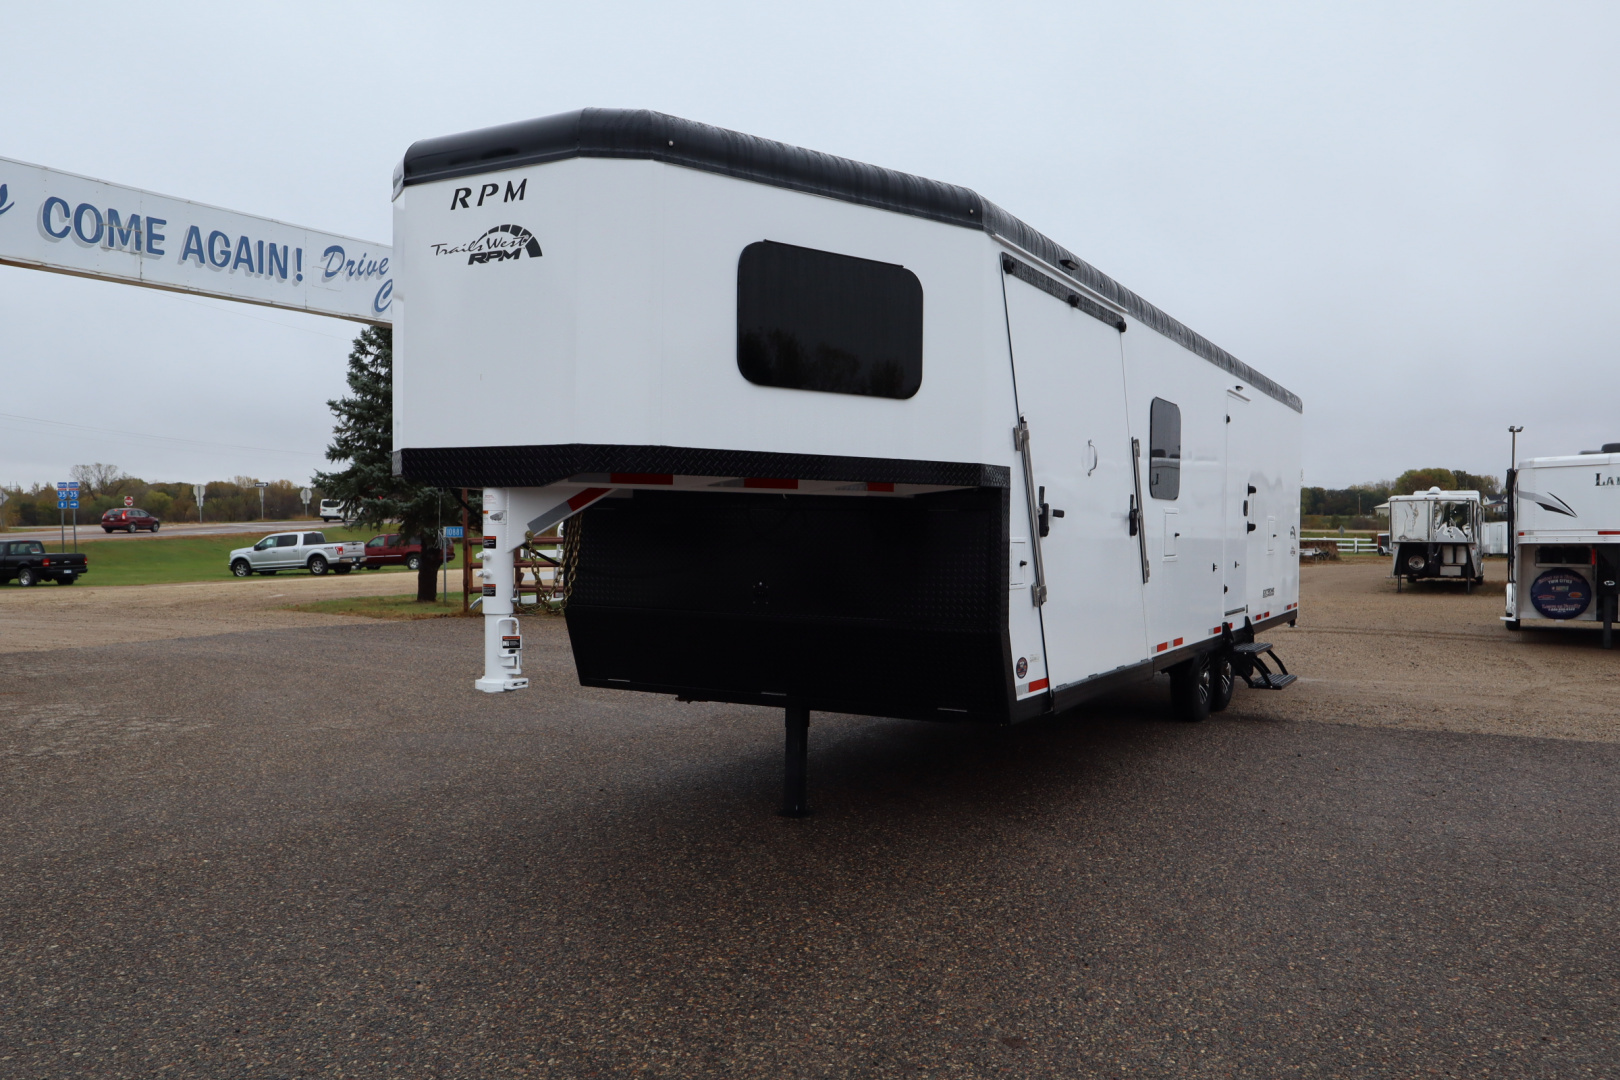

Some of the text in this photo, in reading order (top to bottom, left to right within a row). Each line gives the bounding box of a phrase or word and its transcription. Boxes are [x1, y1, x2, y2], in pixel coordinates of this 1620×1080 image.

[450, 178, 527, 210] RPM
[41, 196, 167, 257] COME
[181, 225, 304, 283] AGAIN!
[430, 235, 525, 256] Trails West
[323, 244, 390, 278] Drive
[467, 247, 522, 265] RPM
